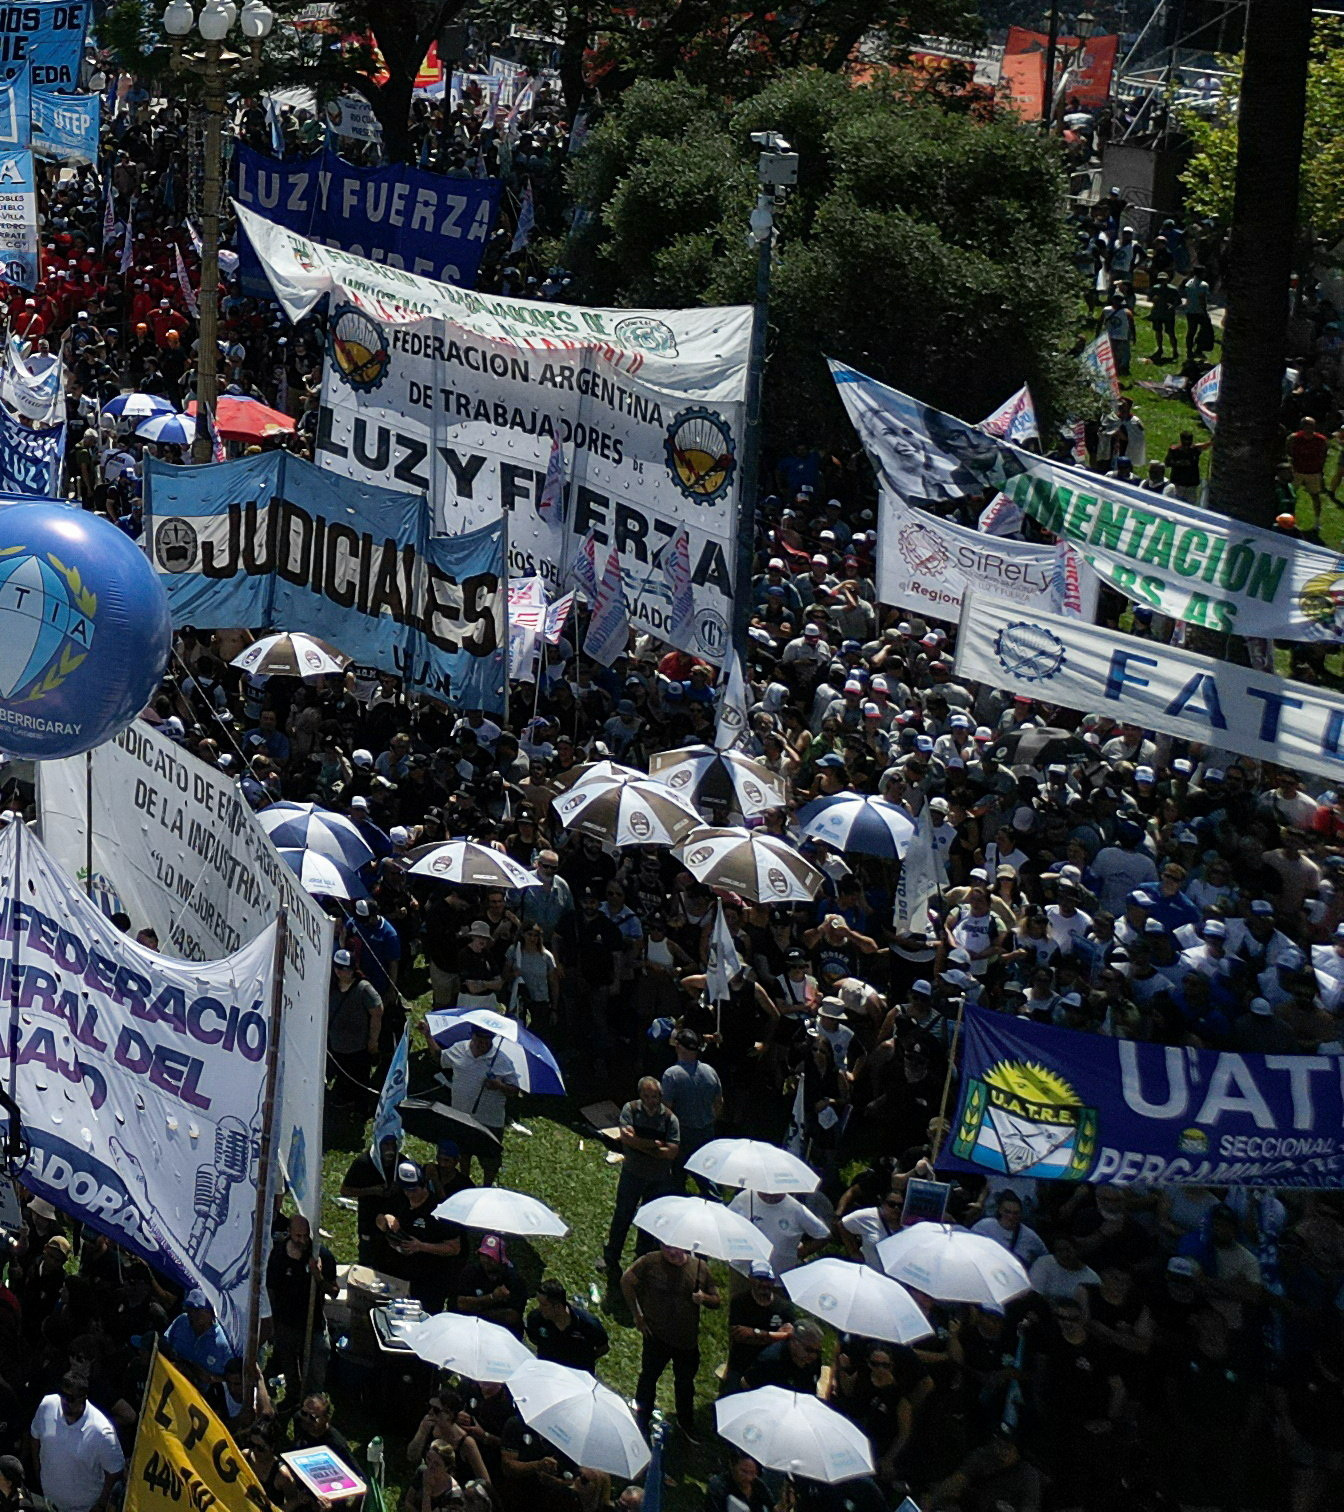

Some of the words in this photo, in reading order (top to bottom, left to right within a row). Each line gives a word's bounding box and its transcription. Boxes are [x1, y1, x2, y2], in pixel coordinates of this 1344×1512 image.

[53, 5, 84, 30] DE
[238, 162, 309, 213] LUZ
[316, 170, 331, 209] Y
[343, 178, 492, 244] FUERZA
[392, 329, 530, 384] FEDERACION
[540, 363, 664, 429] ARGENTINA
[316, 405, 433, 492] LUZ
[437, 447, 488, 499] Y
[409, 380, 433, 411] DE
[440, 388, 624, 466] TRABAJADORES
[199, 496, 498, 658] JUDICIALES
[134, 778, 158, 819] DE
[160, 804, 184, 840] LA
[115, 1028, 213, 1111] DEL
[990, 1088, 1076, 1124] U.A.T.R.E.
[1118, 1039, 1344, 1130] UAT
[1218, 1134, 1332, 1159] SECCIONAL
